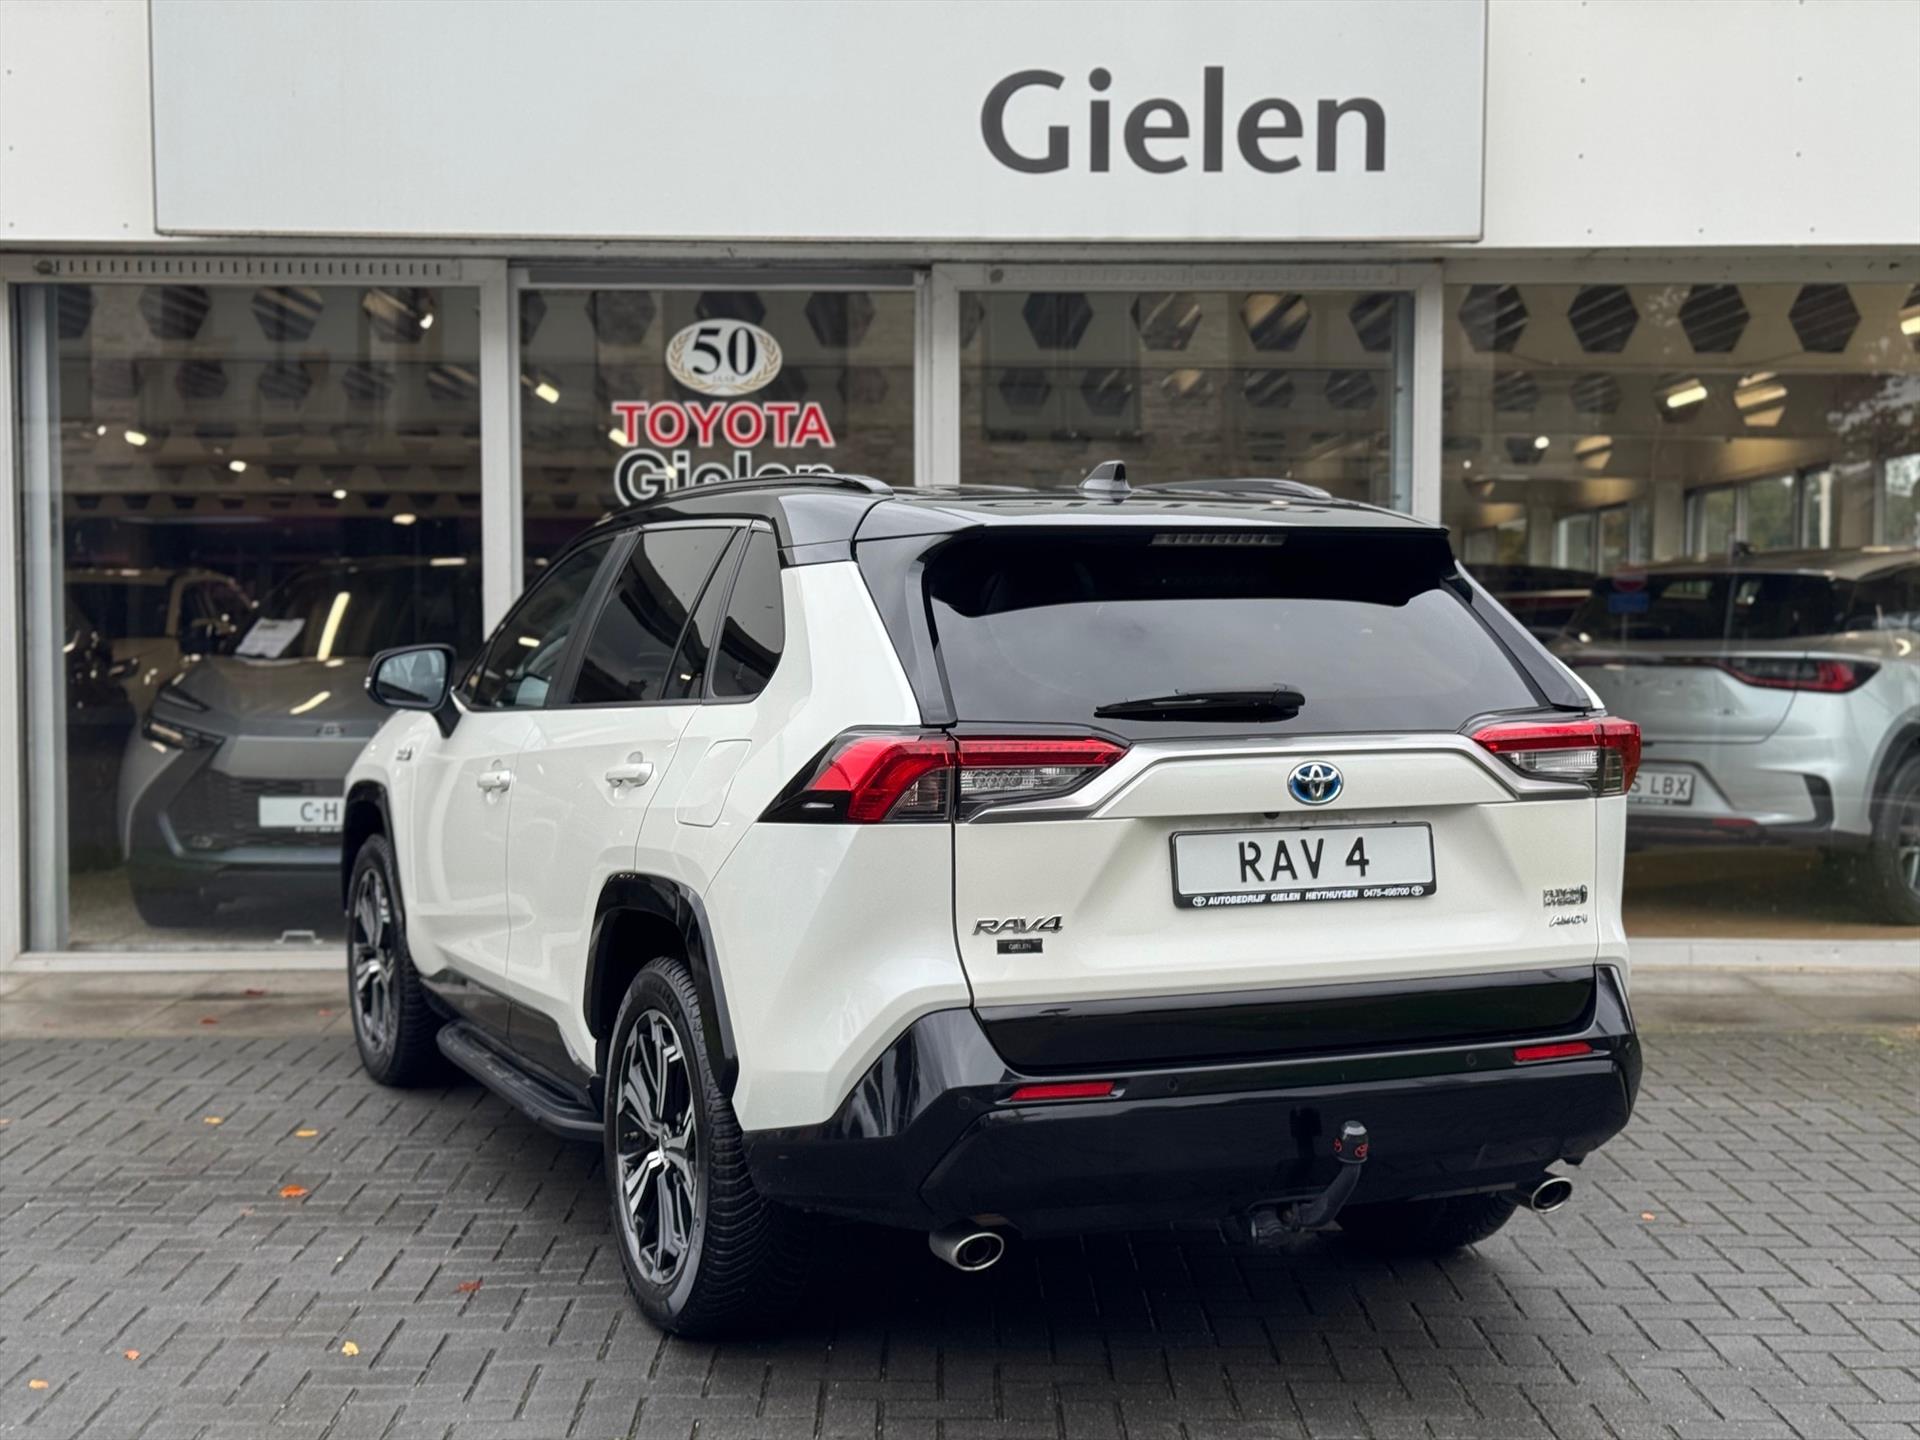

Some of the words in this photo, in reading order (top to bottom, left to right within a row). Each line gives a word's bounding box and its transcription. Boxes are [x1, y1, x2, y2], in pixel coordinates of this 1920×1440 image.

[981, 66, 1386, 174] Gielen
[692, 326, 757, 377] 50
[612, 401, 836, 448] TOYOTA
[614, 449, 835, 506] Giel
[1650, 775, 1689, 797] LBX
[1238, 838, 1324, 883] RAV
[1345, 836, 1370, 877] 4
[1207, 893, 1266, 906] AUTOBEDRIJF
[1270, 891, 1301, 902] GIELEN
[1304, 889, 1358, 901] HEYTHUYSEN
[972, 914, 1064, 936] RAV4
